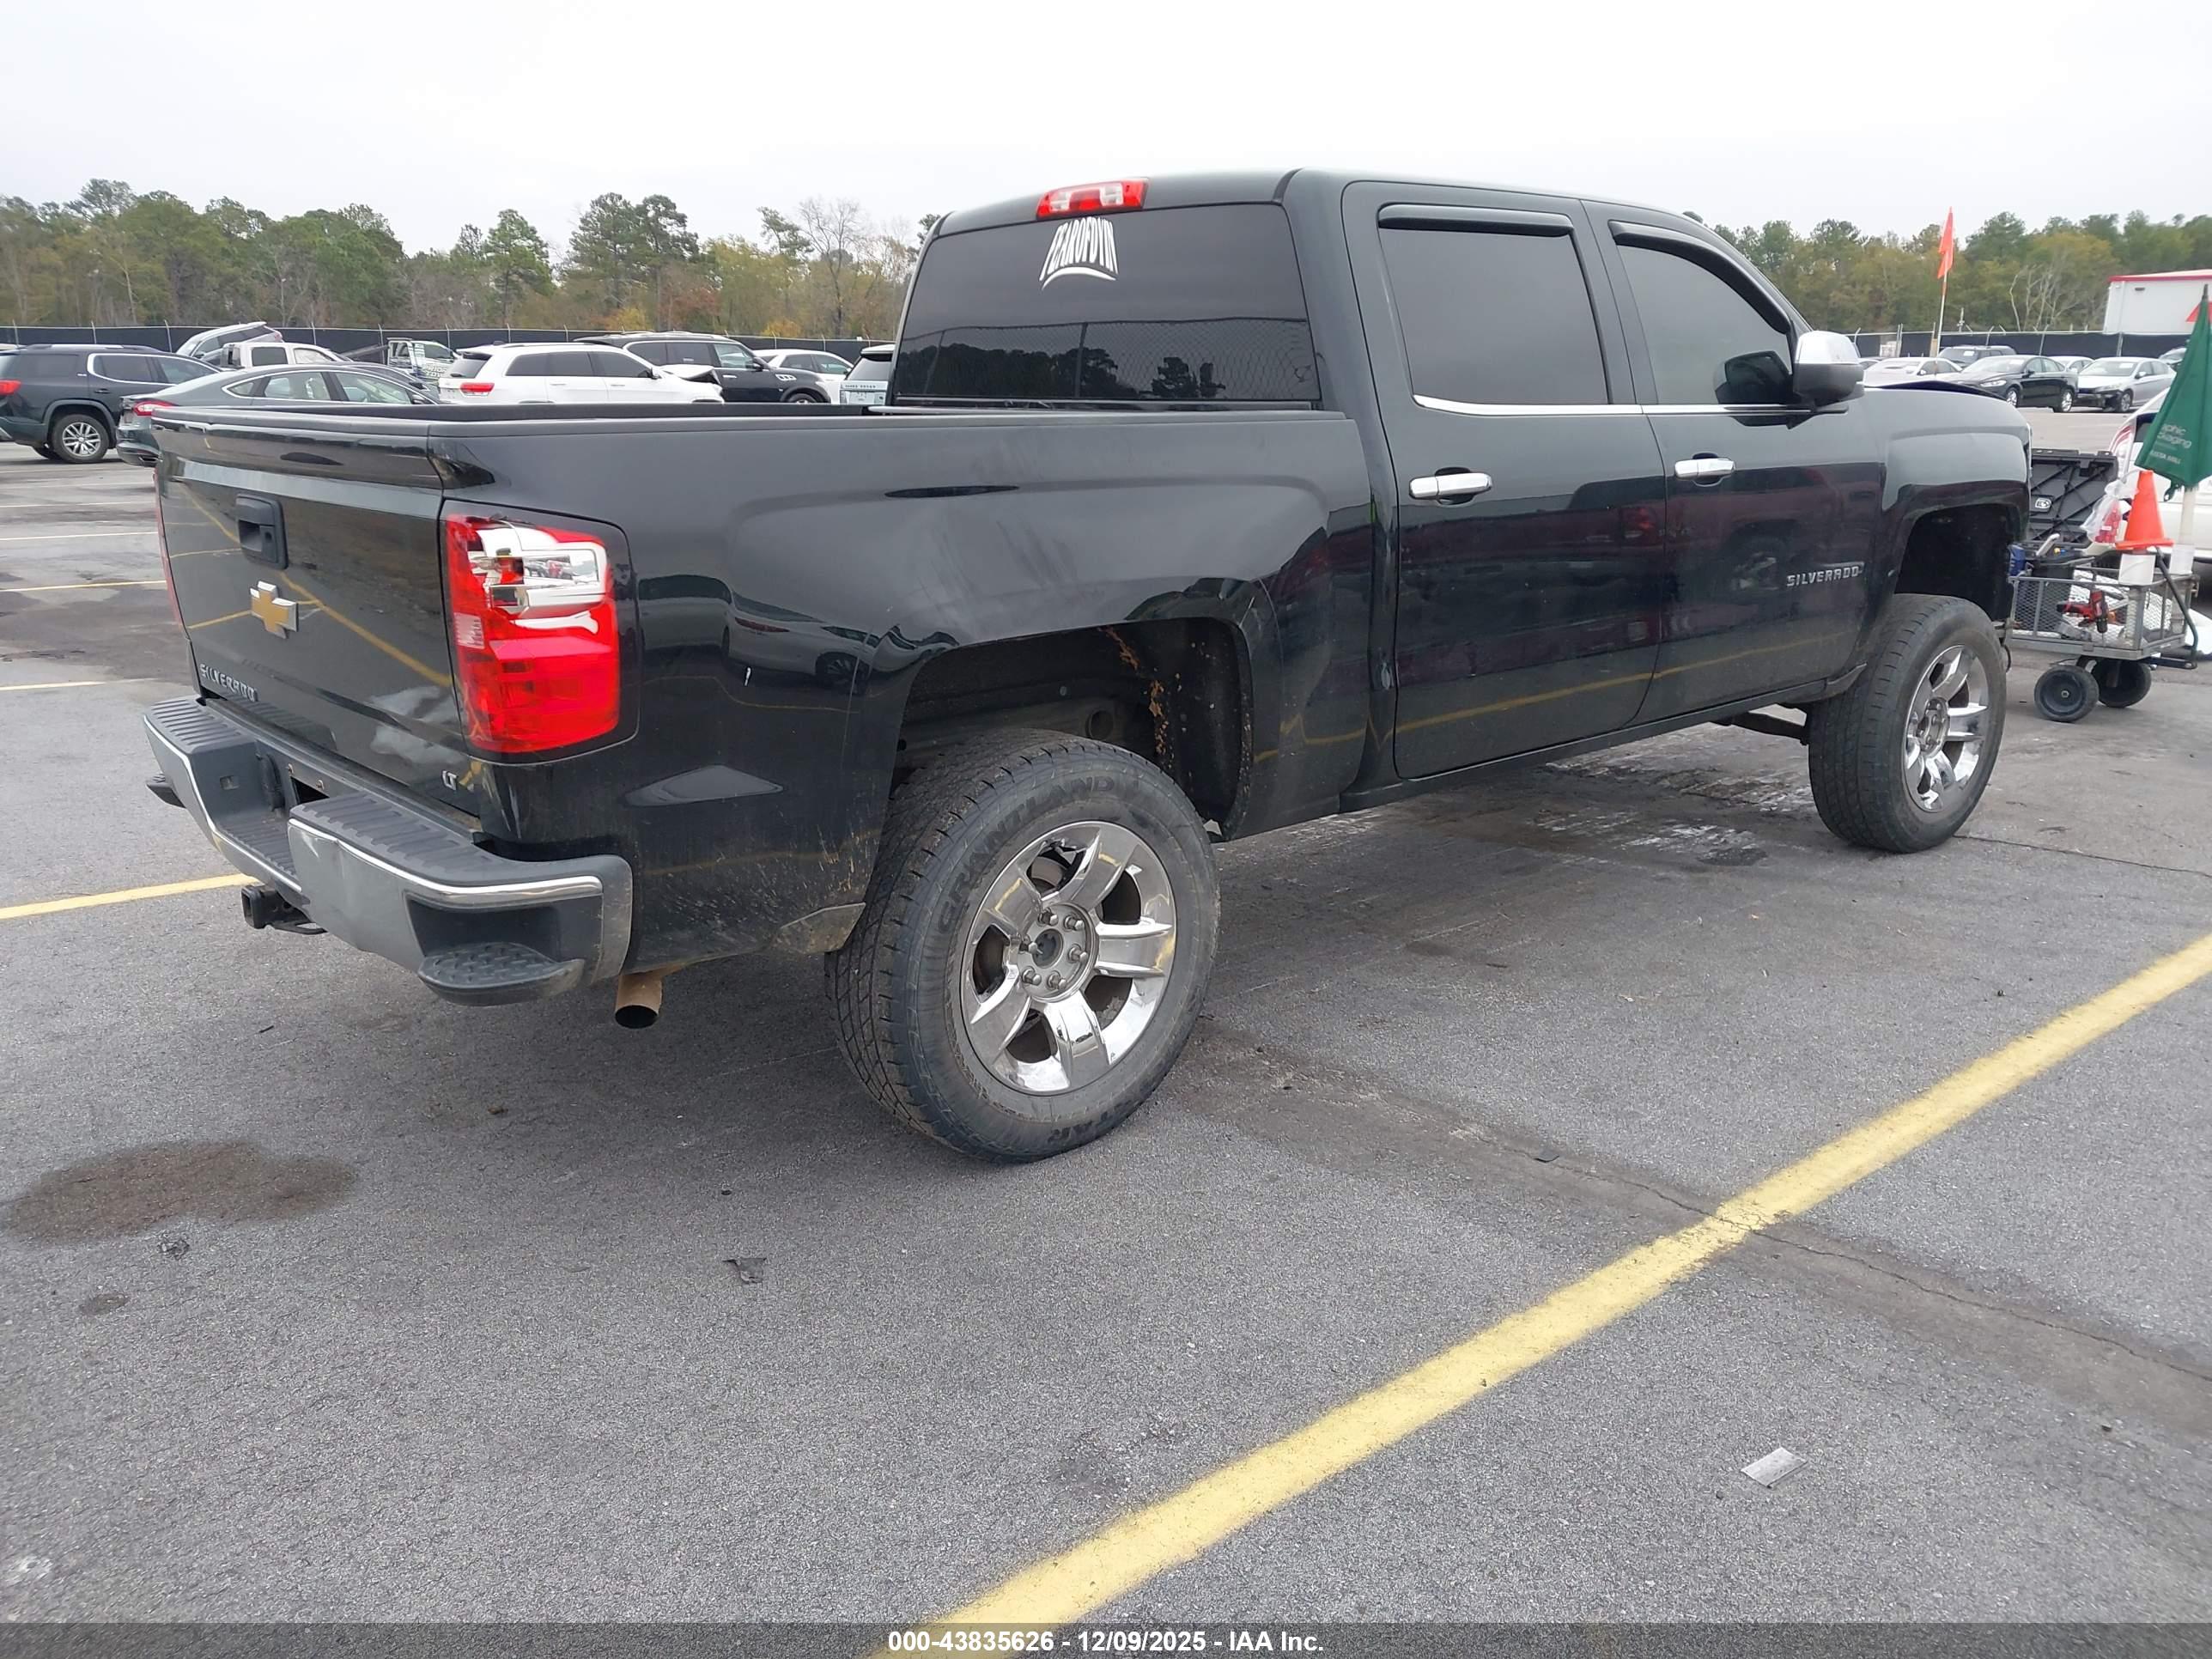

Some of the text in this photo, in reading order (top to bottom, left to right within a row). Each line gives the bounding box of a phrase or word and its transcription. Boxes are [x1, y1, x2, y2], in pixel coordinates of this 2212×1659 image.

[1786, 566, 1860, 587] SILVERADO
[199, 663, 256, 702] SILVERADO
[442, 770, 457, 791] LT
